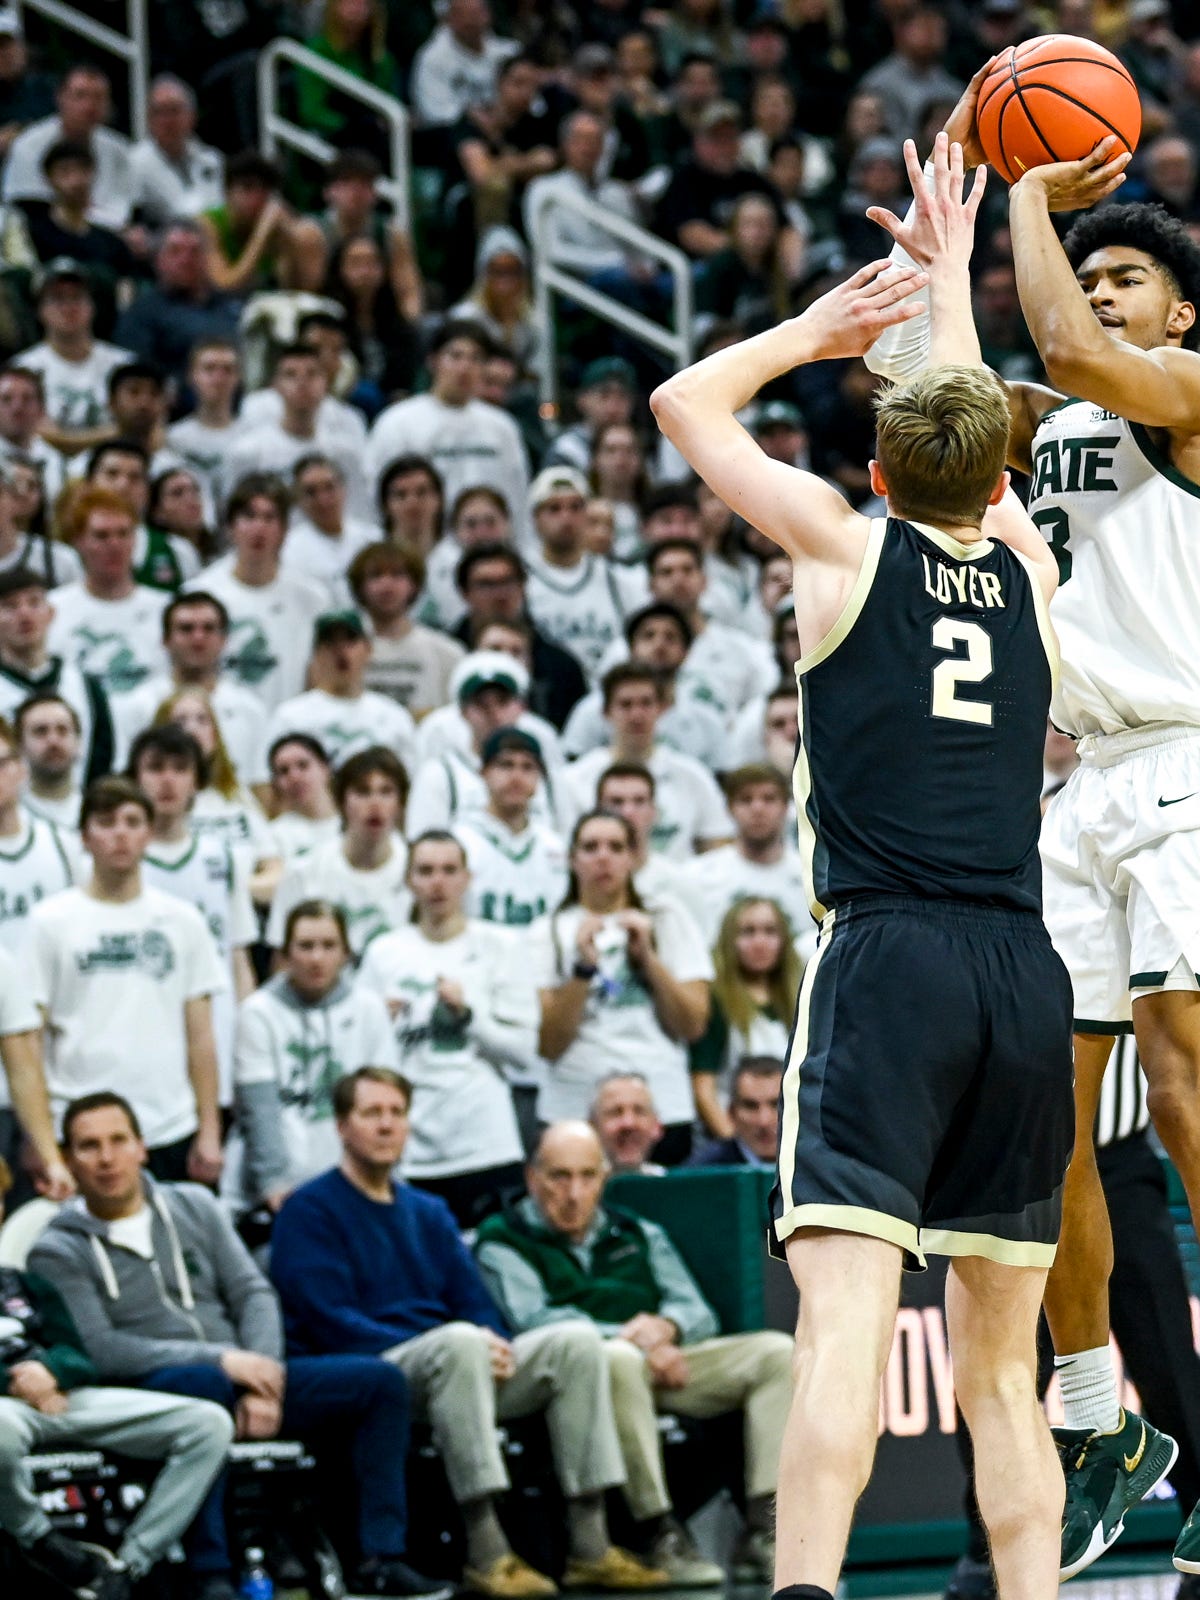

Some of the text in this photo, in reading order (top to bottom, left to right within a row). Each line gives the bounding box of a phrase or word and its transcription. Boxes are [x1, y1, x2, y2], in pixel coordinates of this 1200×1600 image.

[921, 553, 1006, 608] LOYER
[1031, 506, 1073, 587] 3
[931, 615, 994, 728] 2
